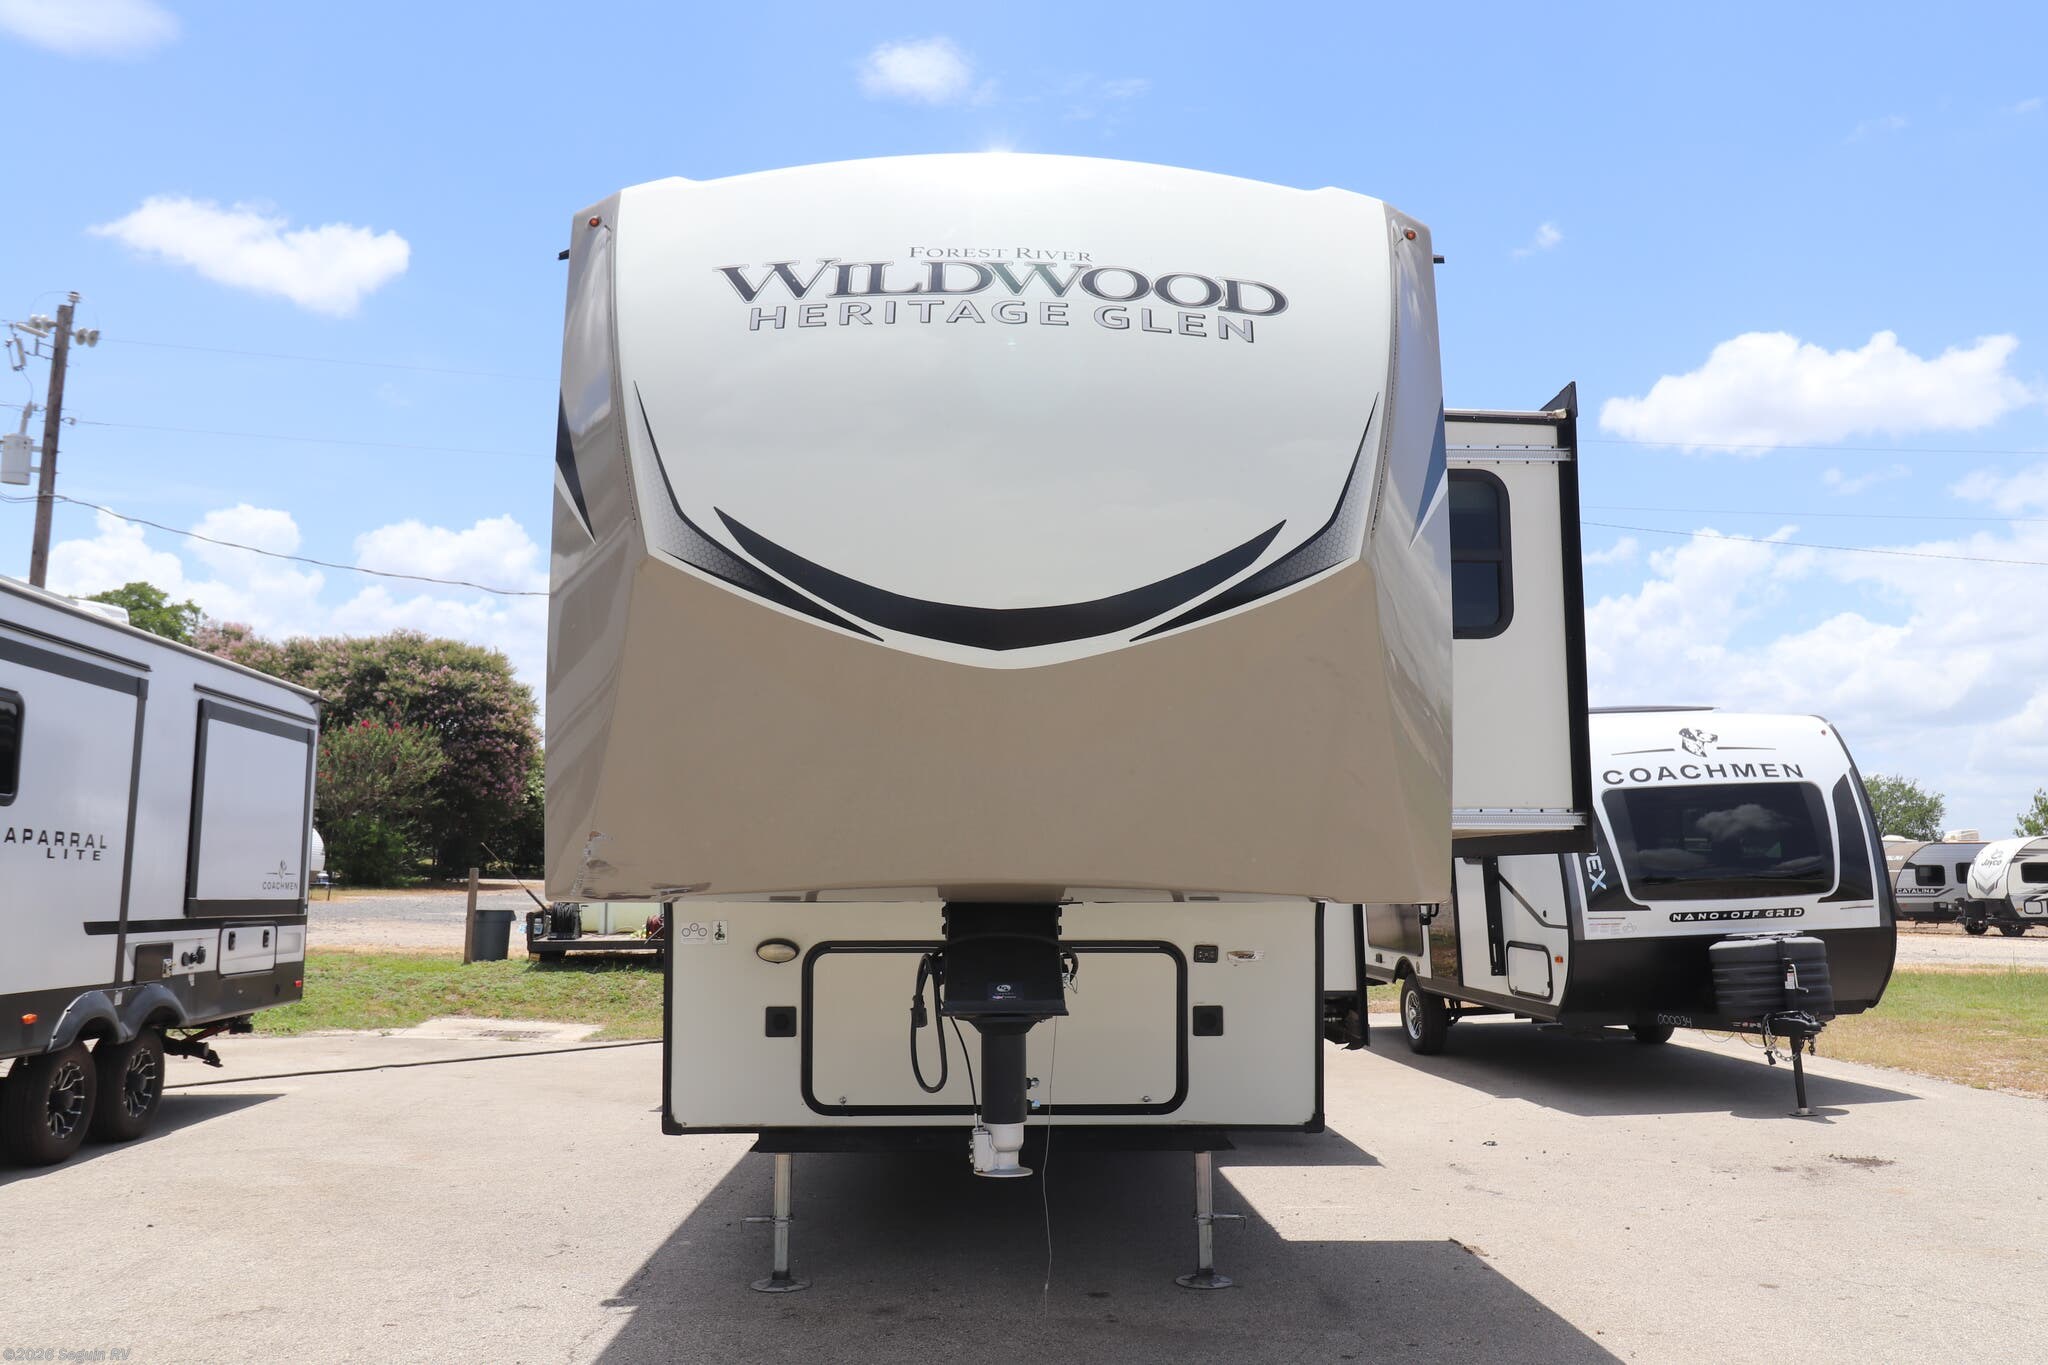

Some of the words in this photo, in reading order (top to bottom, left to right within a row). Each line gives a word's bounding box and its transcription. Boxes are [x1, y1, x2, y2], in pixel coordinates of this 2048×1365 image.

[909, 246, 1008, 258] FOREST
[1016, 247, 1093, 262] RIVER
[712, 257, 1289, 317] WILDWOOD
[749, 301, 1069, 331] HERITAGE
[1094, 305, 1255, 343] GLEN
[1602, 763, 1804, 785] COACHMEN
[46, 847, 101, 861] LITE
[262, 881, 298, 890] COACHMEN
[1672, 912, 1719, 921] NANO
[1765, 908, 1803, 917] GRID
